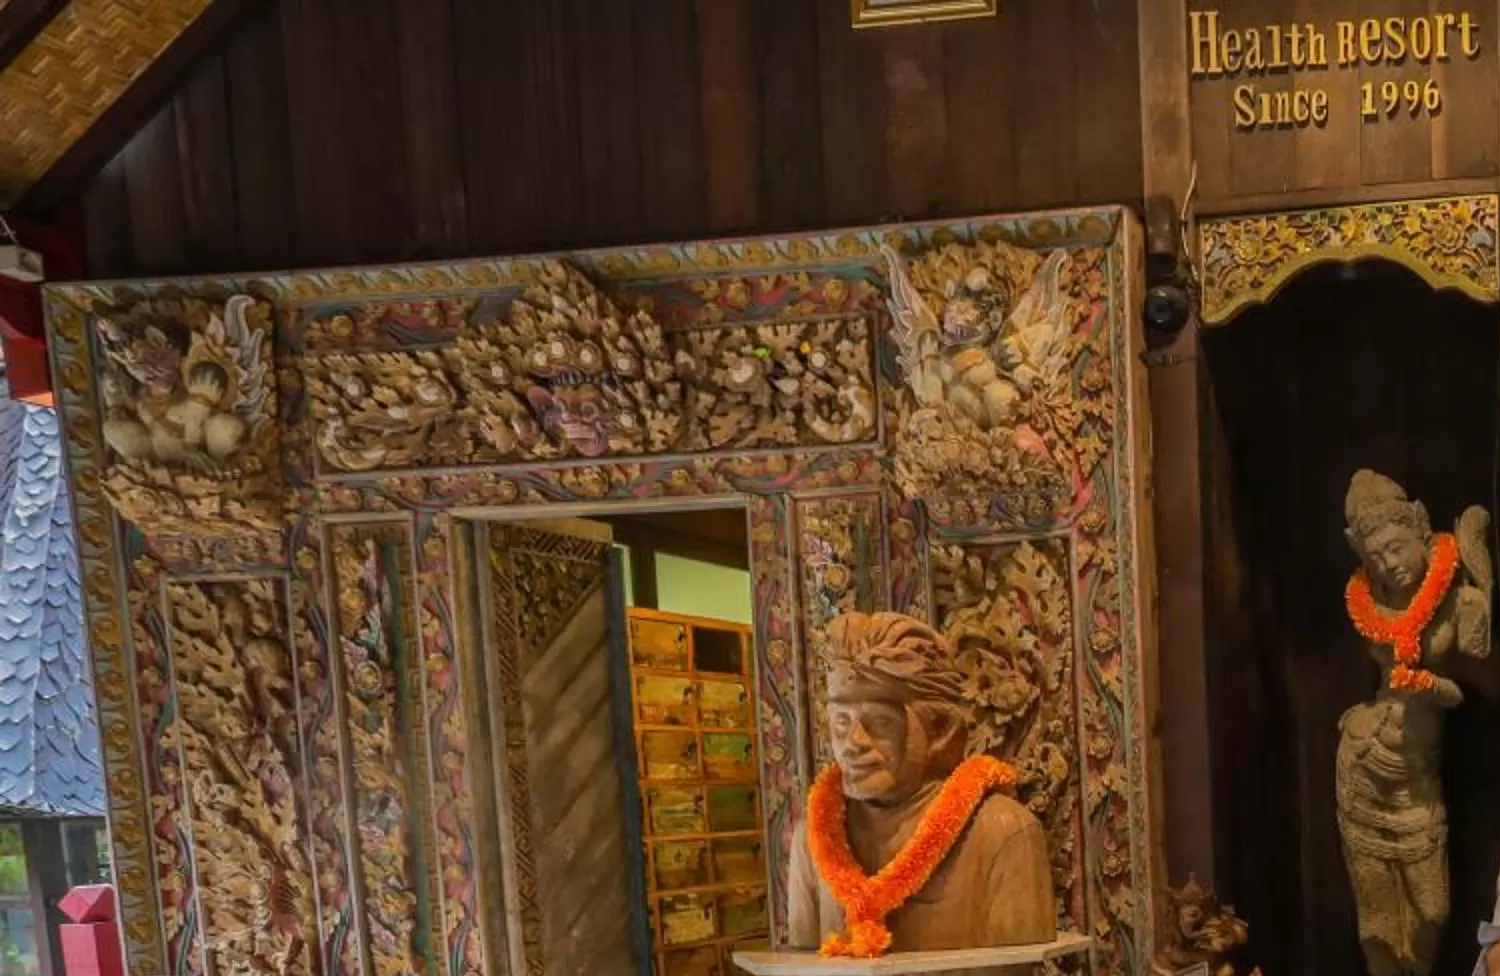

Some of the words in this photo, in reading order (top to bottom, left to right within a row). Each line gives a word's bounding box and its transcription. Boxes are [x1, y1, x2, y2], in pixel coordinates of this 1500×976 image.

[1189, 10, 1328, 74] Health
[1336, 11, 1480, 65] Resort
[1233, 84, 1328, 127] Since
[1360, 79, 1441, 117] 1996
